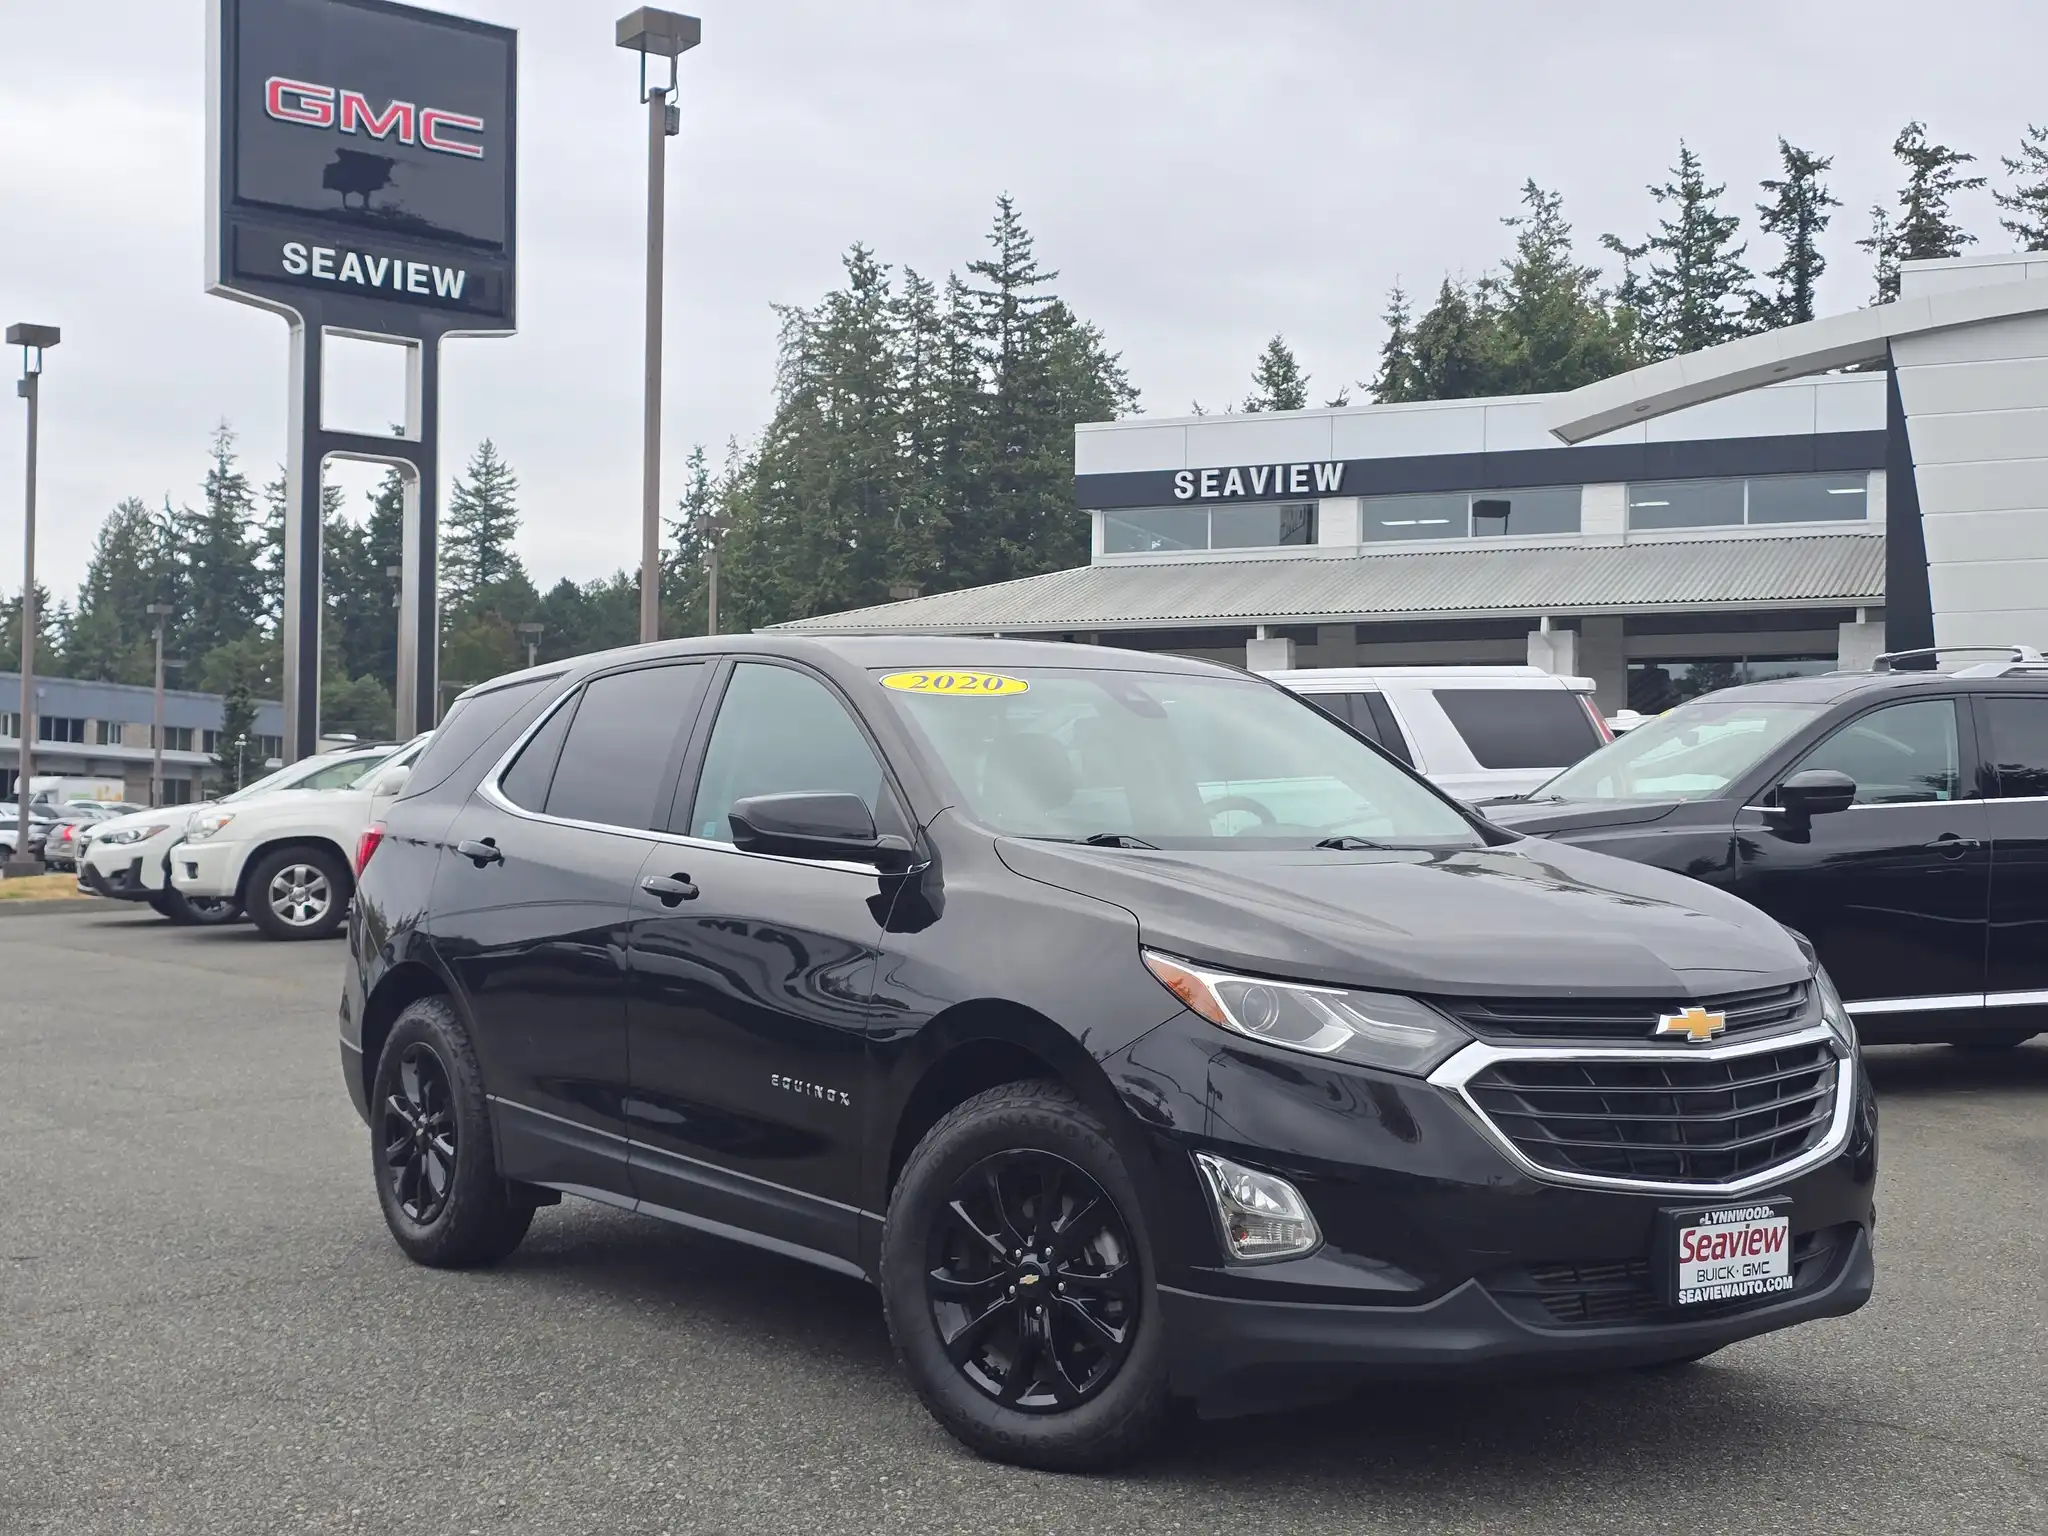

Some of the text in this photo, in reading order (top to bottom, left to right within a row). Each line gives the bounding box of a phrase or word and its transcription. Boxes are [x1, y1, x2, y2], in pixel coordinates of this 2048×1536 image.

[265, 76, 484, 159] GMC
[282, 242, 465, 299] SEAVIEW
[1174, 462, 1344, 499] SEAVIEW
[909, 675, 1003, 690] 2020
[771, 1073, 850, 1106] EQUINOX
[1704, 1206, 1769, 1225] LYNNWOOD
[1679, 1223, 1787, 1263] Seaview
[1696, 1260, 1770, 1283] BUICK GMC
[1678, 1275, 1793, 1304] SEAVIEWAUTO.COM
